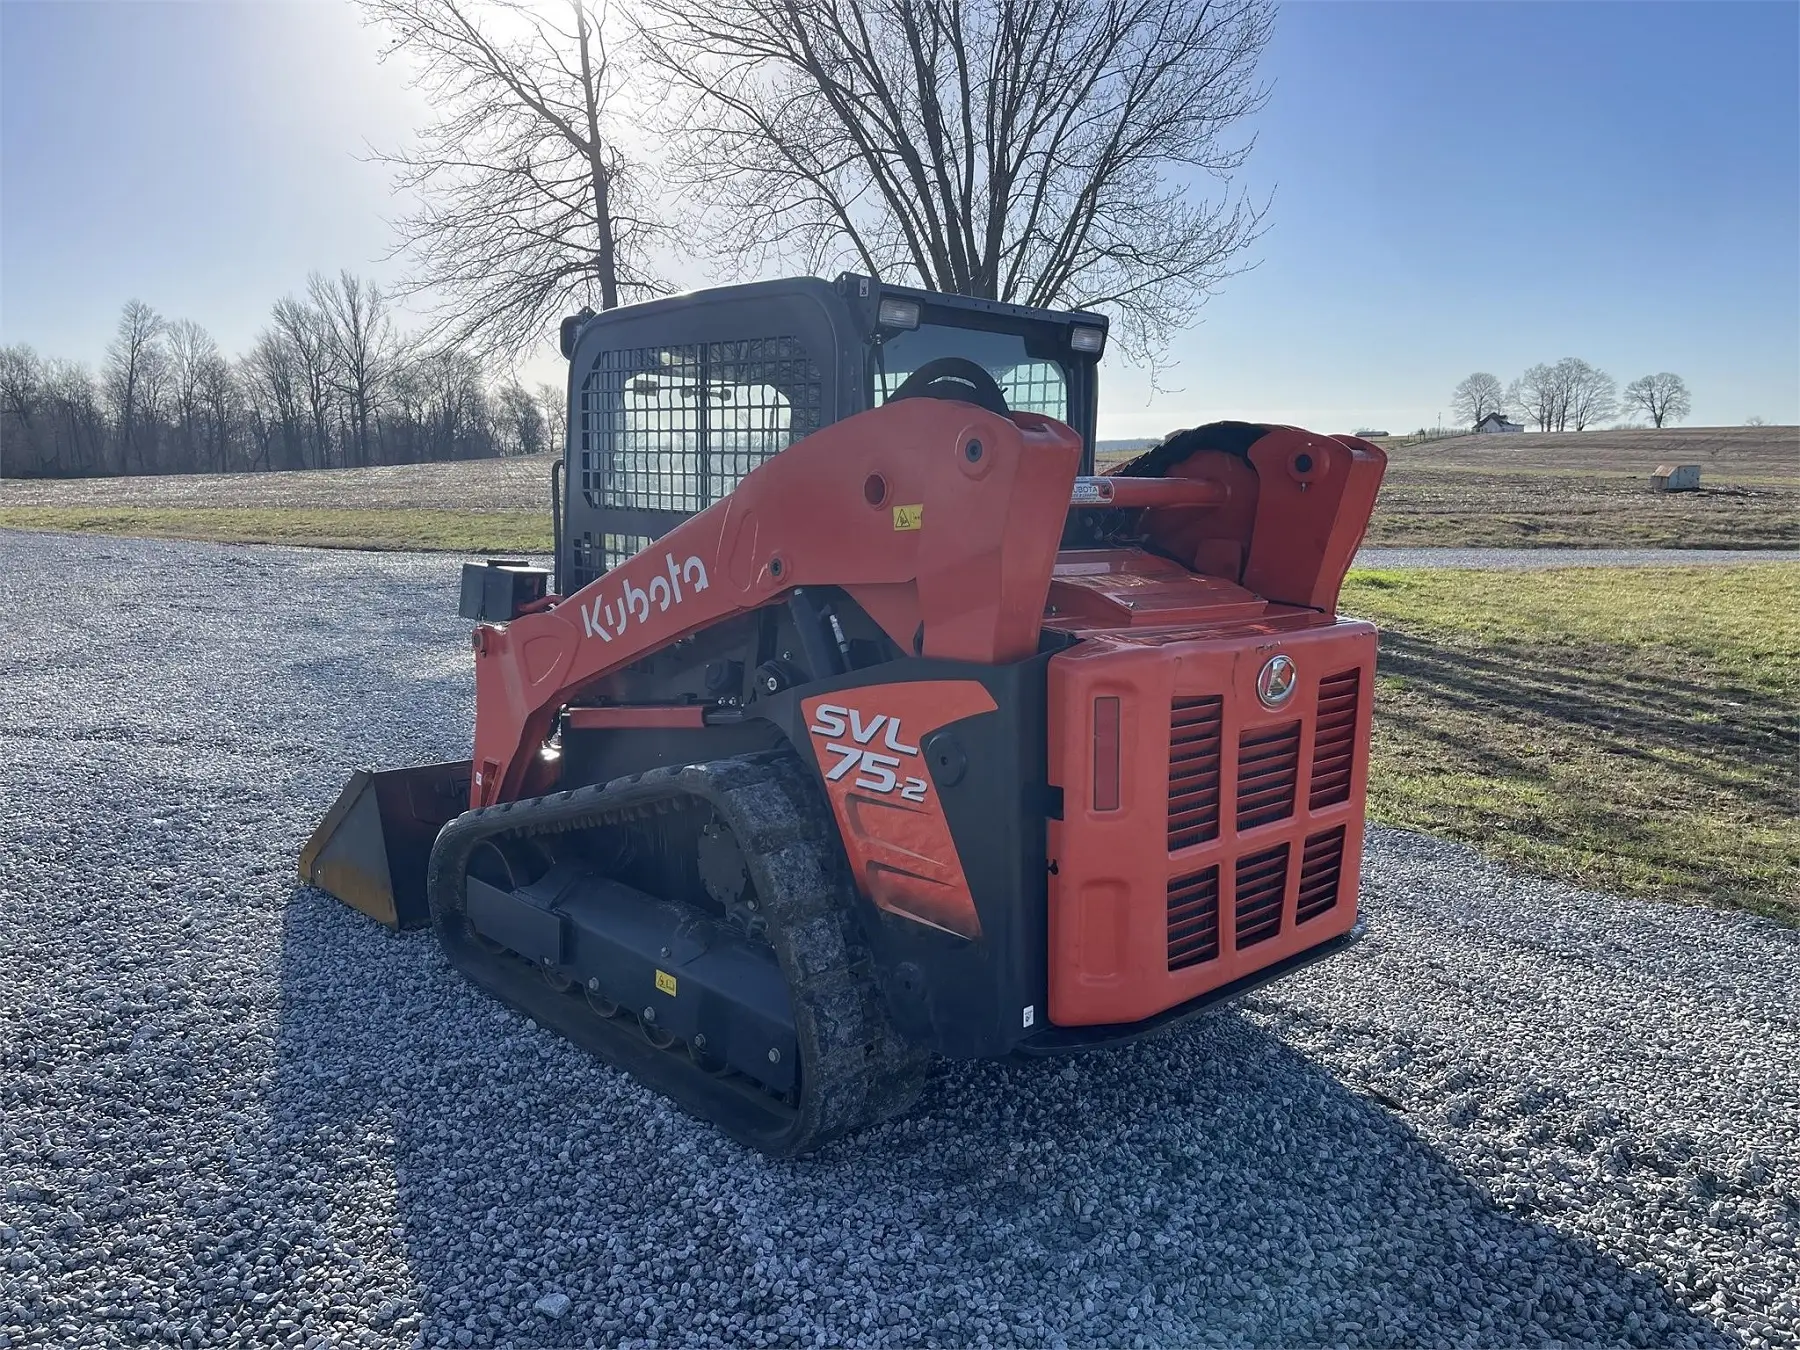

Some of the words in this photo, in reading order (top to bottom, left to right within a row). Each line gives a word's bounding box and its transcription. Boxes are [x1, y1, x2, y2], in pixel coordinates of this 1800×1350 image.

[580, 552, 709, 642] Kubota
[811, 703, 918, 755] SVL
[825, 742, 928, 802] 75-2
